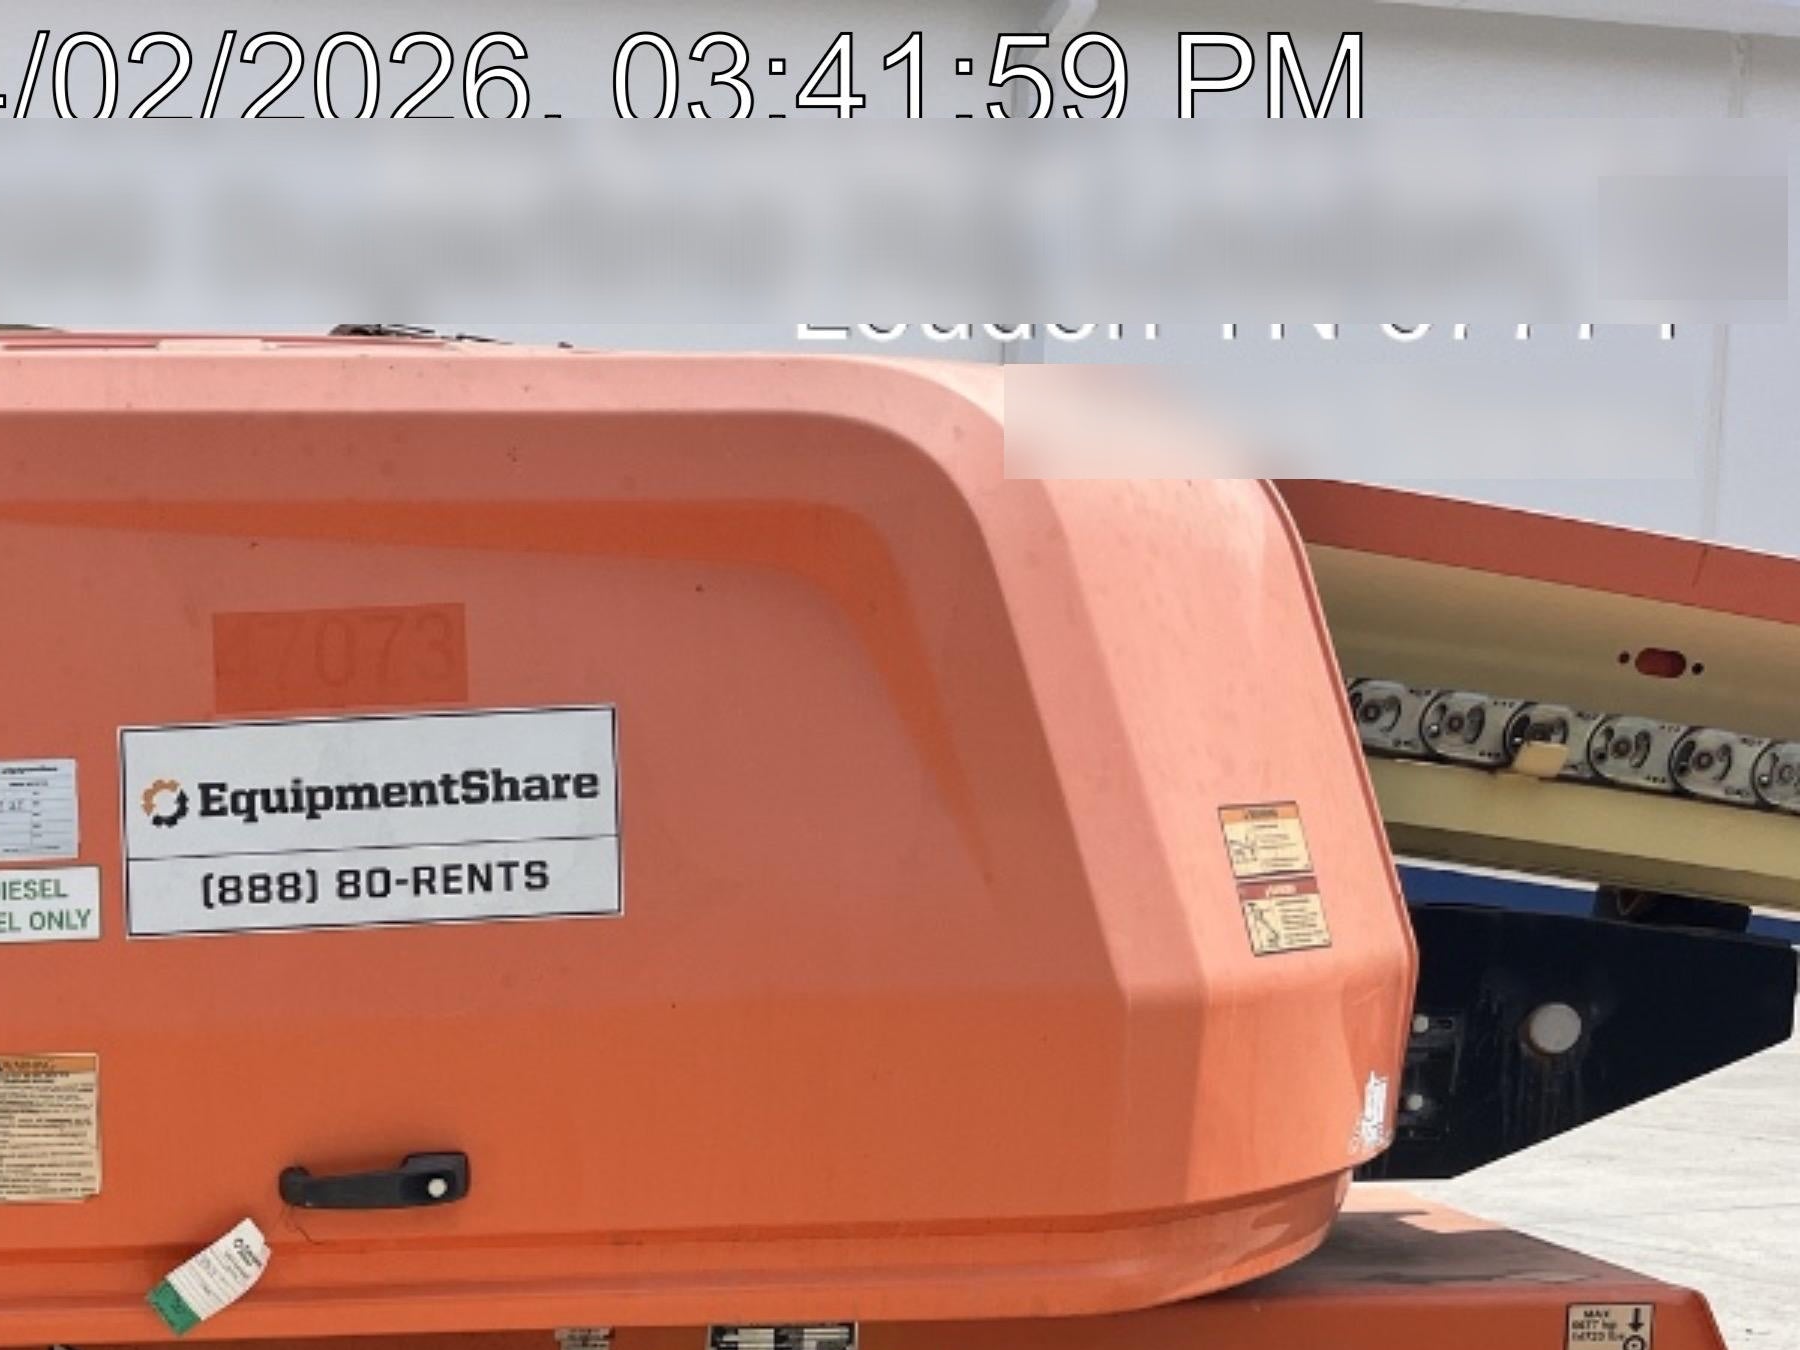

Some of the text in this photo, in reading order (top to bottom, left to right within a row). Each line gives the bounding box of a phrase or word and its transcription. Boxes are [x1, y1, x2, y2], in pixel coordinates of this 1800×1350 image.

[198, 768, 600, 823] EquipmentShare
[202, 859, 551, 910] (888) 80-RENTS
[29, 907, 92, 931] ONLY
